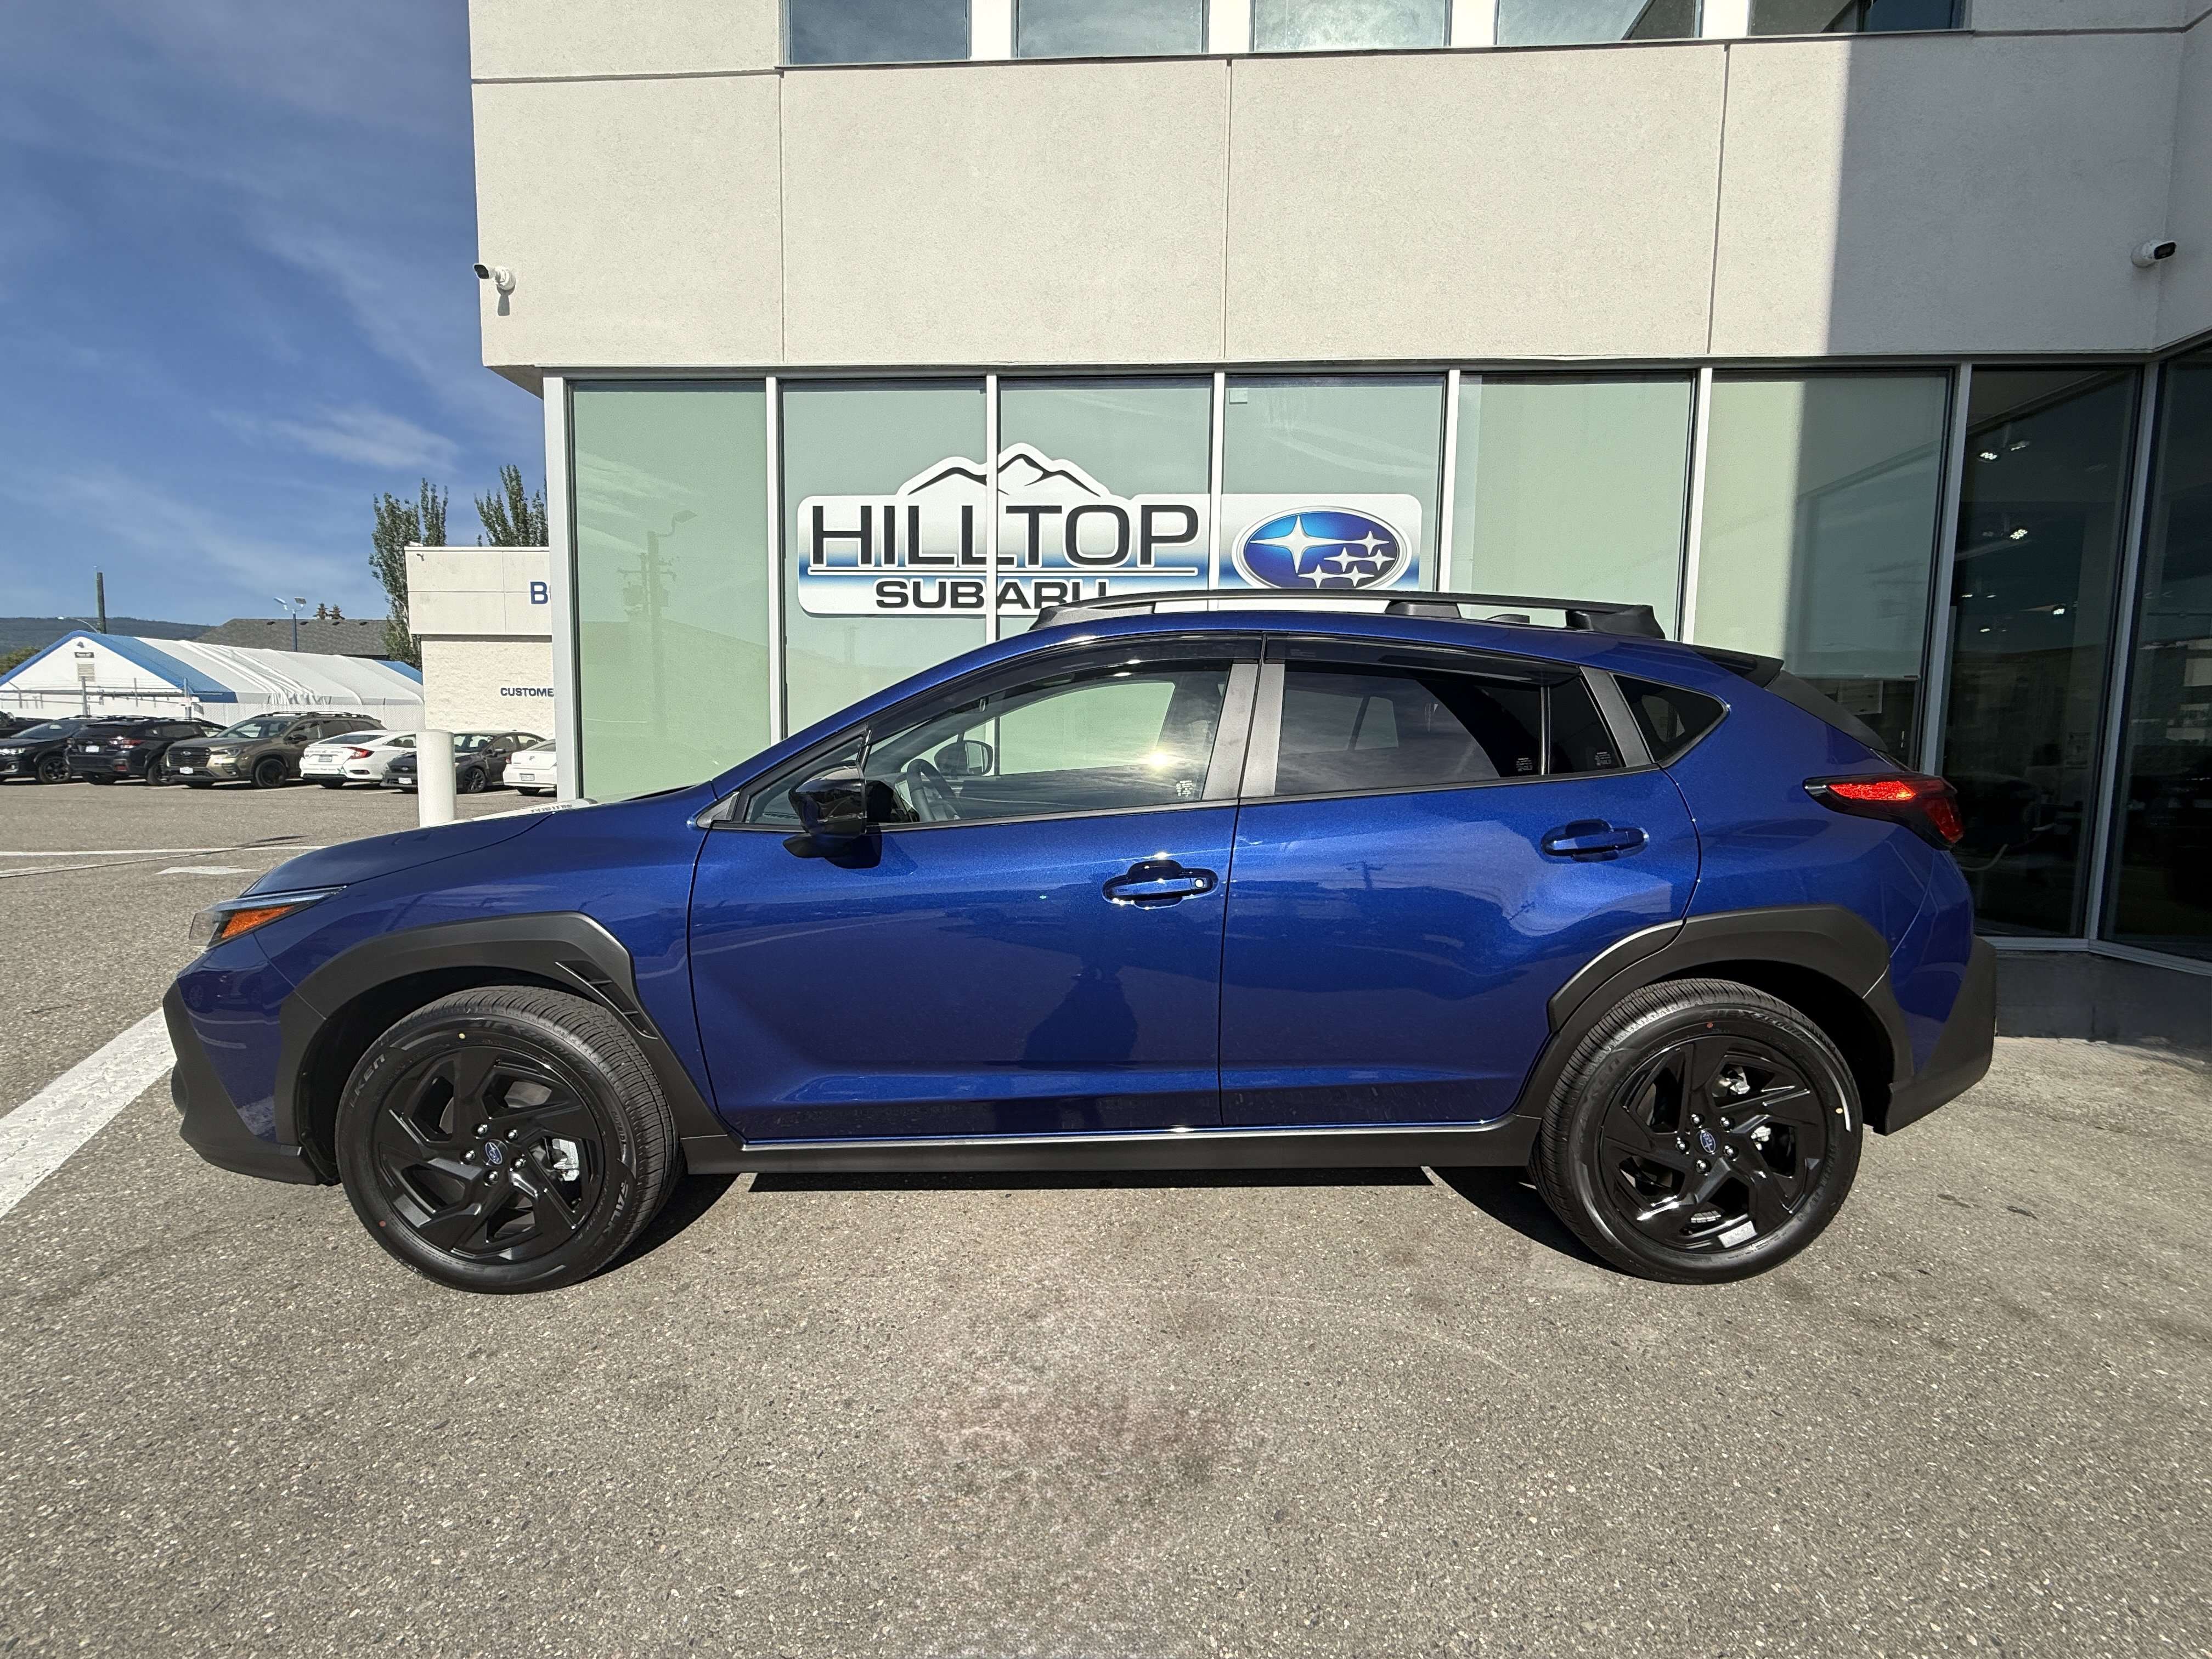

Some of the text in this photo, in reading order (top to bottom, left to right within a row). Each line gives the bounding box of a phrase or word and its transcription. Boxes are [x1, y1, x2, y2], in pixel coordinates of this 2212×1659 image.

[812, 504, 1199, 565] HILLTOP
[530, 581, 551, 605] B
[500, 687, 554, 697] CUSTOME
